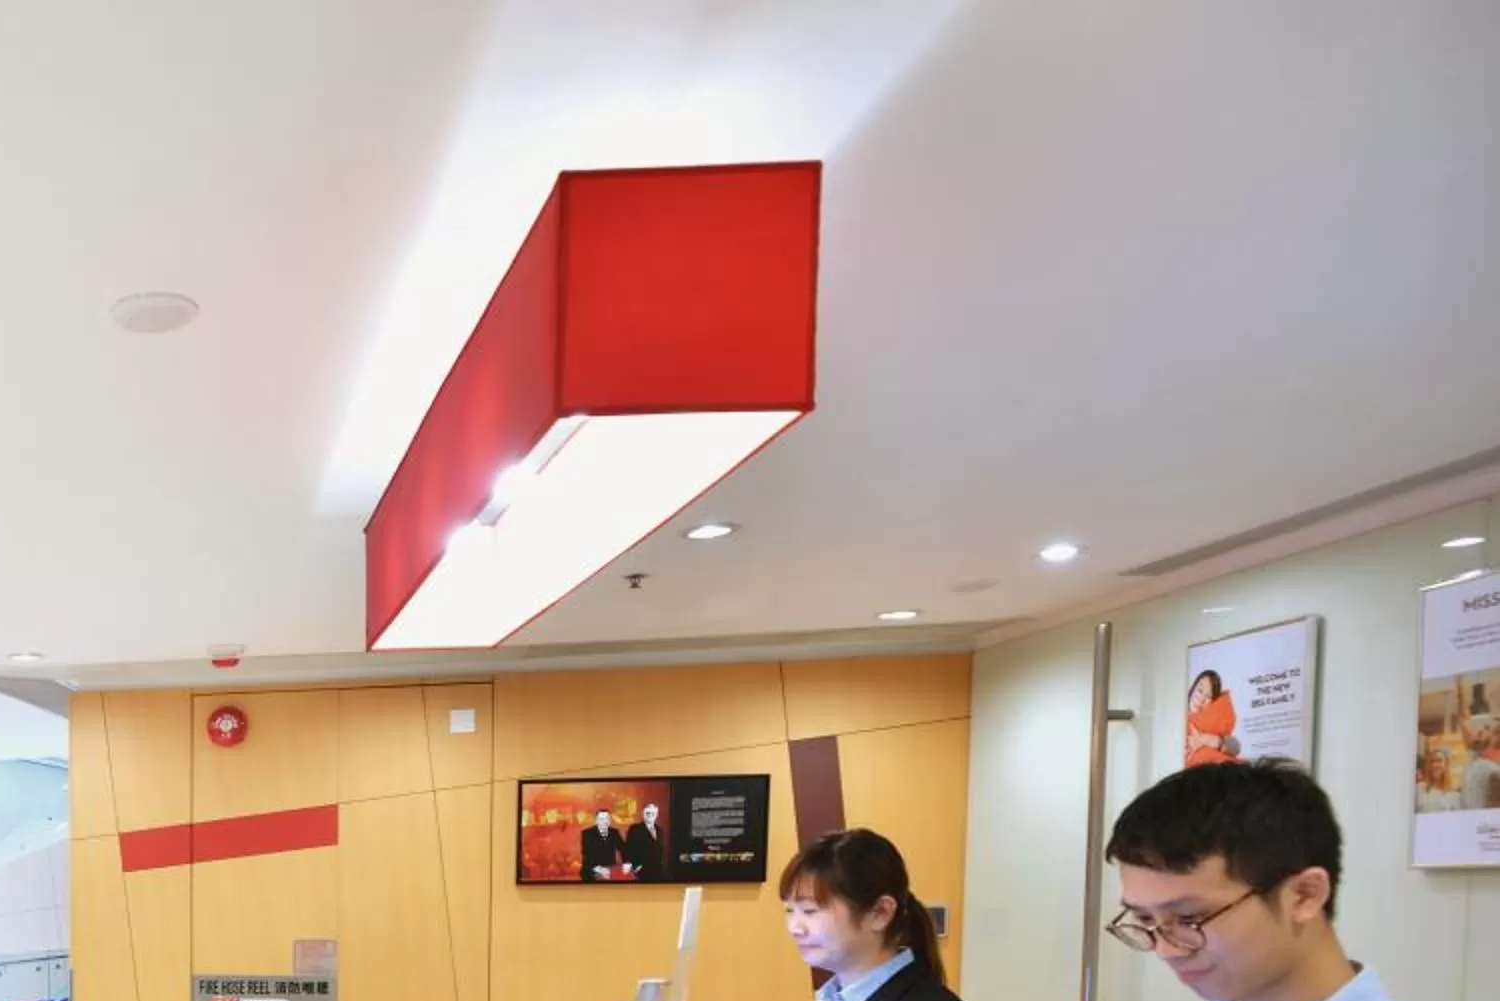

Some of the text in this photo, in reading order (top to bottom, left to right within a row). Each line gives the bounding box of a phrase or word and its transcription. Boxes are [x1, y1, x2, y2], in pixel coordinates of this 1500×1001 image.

[1249, 672, 1287, 684] WELCOME
[1257, 686, 1272, 694] THE
[199, 980, 270, 994] FIRE HOSE REEL
